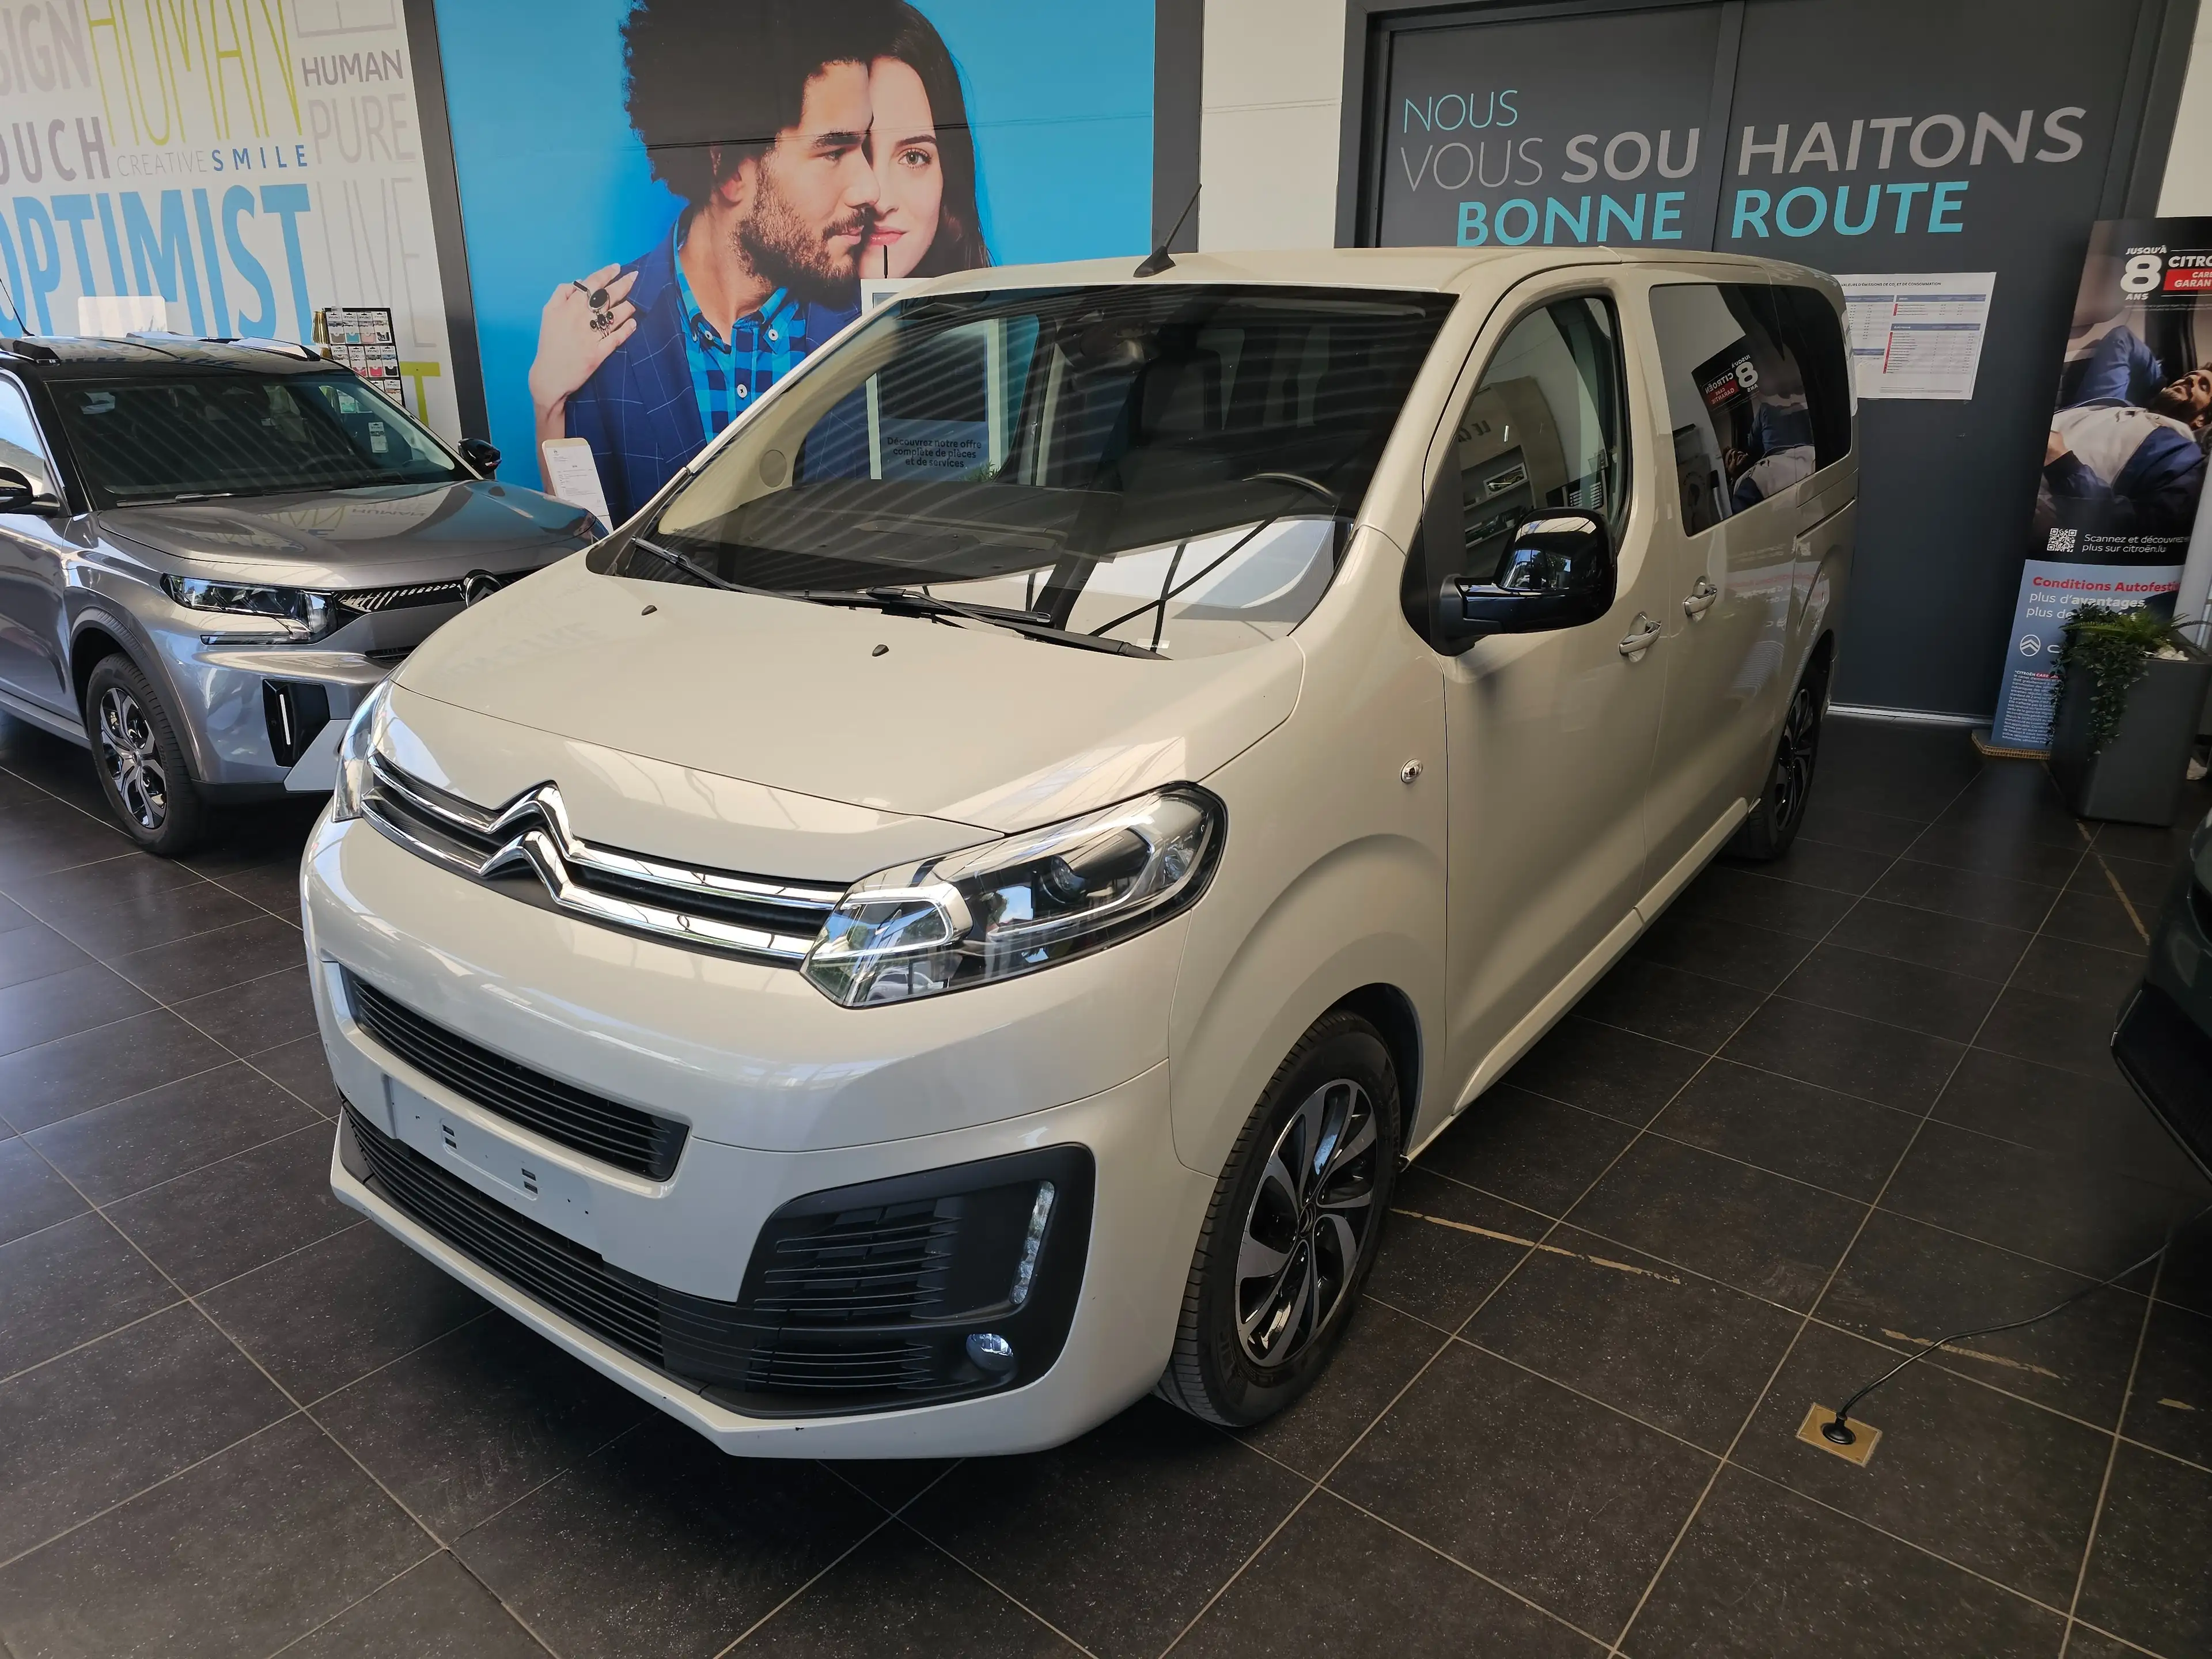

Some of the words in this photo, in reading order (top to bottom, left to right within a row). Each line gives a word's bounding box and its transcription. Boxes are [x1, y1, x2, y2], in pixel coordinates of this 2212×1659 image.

[301, 50, 403, 86] HUMAN
[1404, 89, 1518, 133] NOUS
[308, 93, 416, 165] PURE
[118, 150, 208, 177] CREATIVE
[211, 145, 308, 171] SMILE
[1400, 137, 1543, 192] VOUS
[1457, 191, 1685, 247] BONNE
[1731, 181, 1969, 238] ROUTE
[2125, 245, 2167, 255] JUSQU'À
[2120, 255, 2162, 293] 8
[887, 437, 933, 446] Découvrez
[960, 440, 982, 448] offre
[893, 447, 934, 457] complète
[935, 449, 946, 457] de
[948, 449, 976, 459] pièces
[2082, 544, 2103, 552] plus
[2084, 534, 2126, 543] Scannez
[2033, 576, 2111, 591] Conditions
[2029, 592, 2056, 604] plus
[2026, 607, 2053, 618] plus
